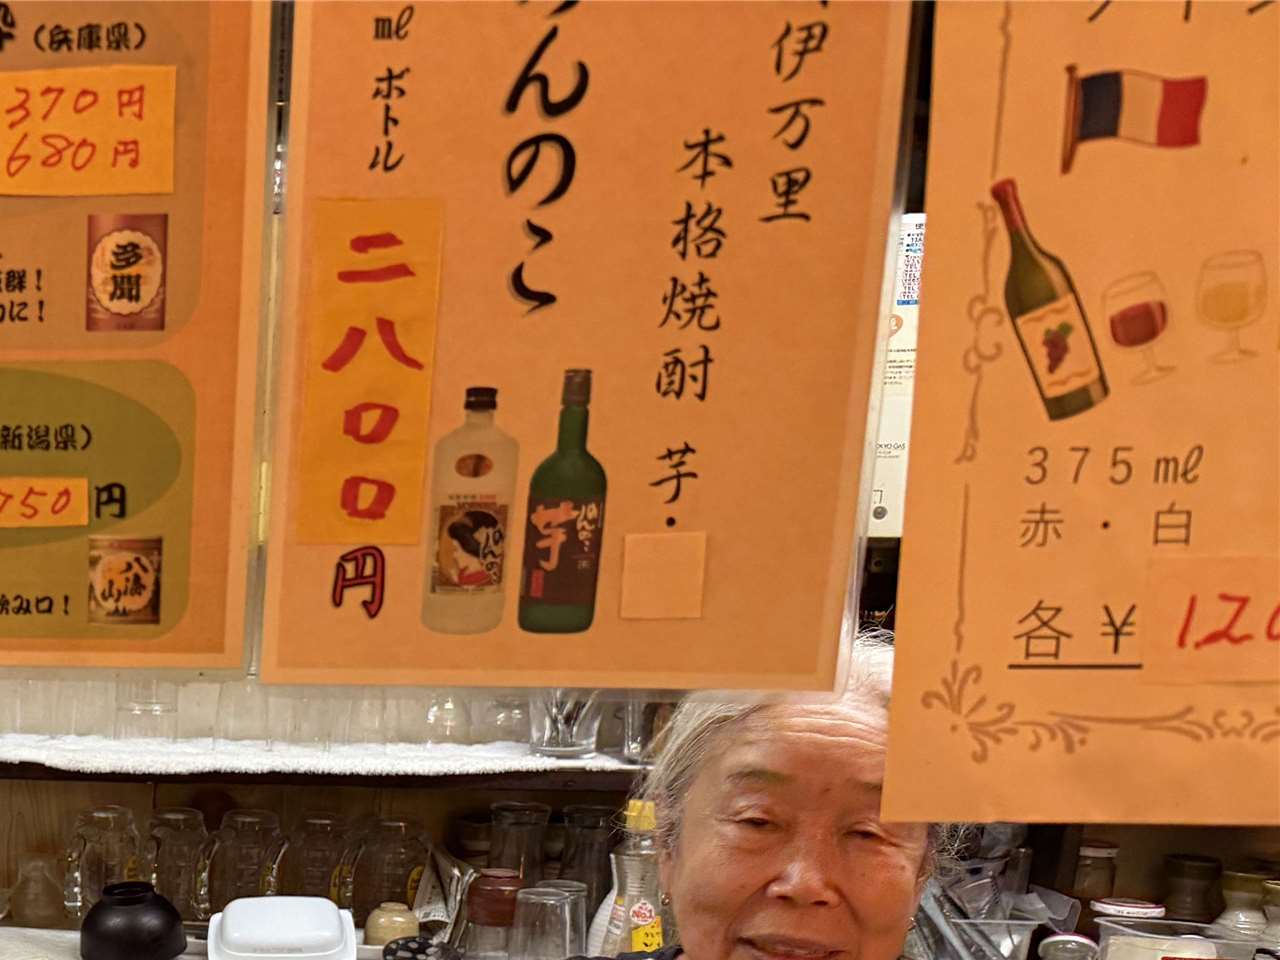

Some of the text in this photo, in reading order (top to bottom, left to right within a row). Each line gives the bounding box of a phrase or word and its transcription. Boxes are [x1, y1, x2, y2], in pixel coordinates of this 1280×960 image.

[33, 22, 147, 51] （兵庫県）
[504, 0, 590, 318] んのこ
[656, 128, 733, 402] 本格焼酎
